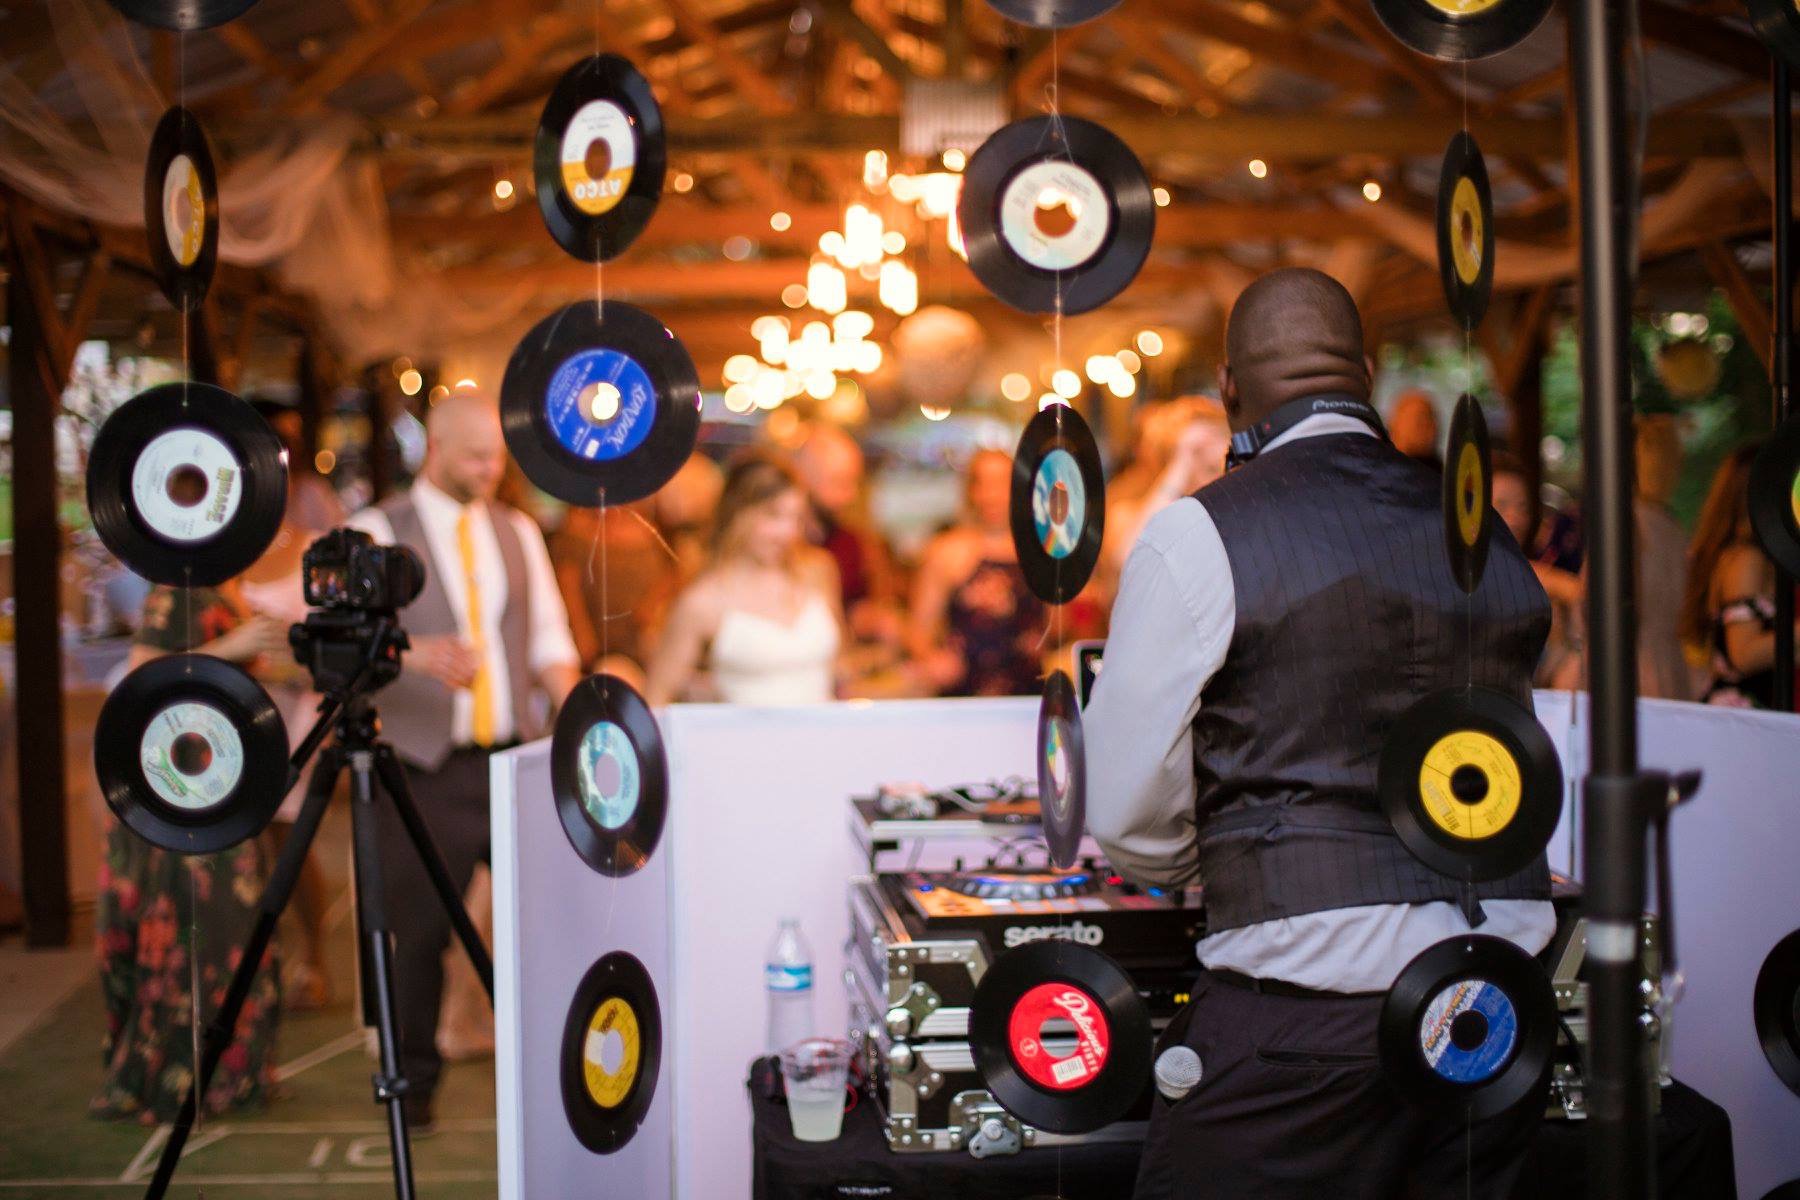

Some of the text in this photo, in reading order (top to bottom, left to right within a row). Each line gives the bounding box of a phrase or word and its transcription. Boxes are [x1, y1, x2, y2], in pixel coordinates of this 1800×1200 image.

[574, 178, 622, 200] ATCO
[1003, 920, 1104, 948] serato
[1053, 992, 1105, 1058] Delicious
